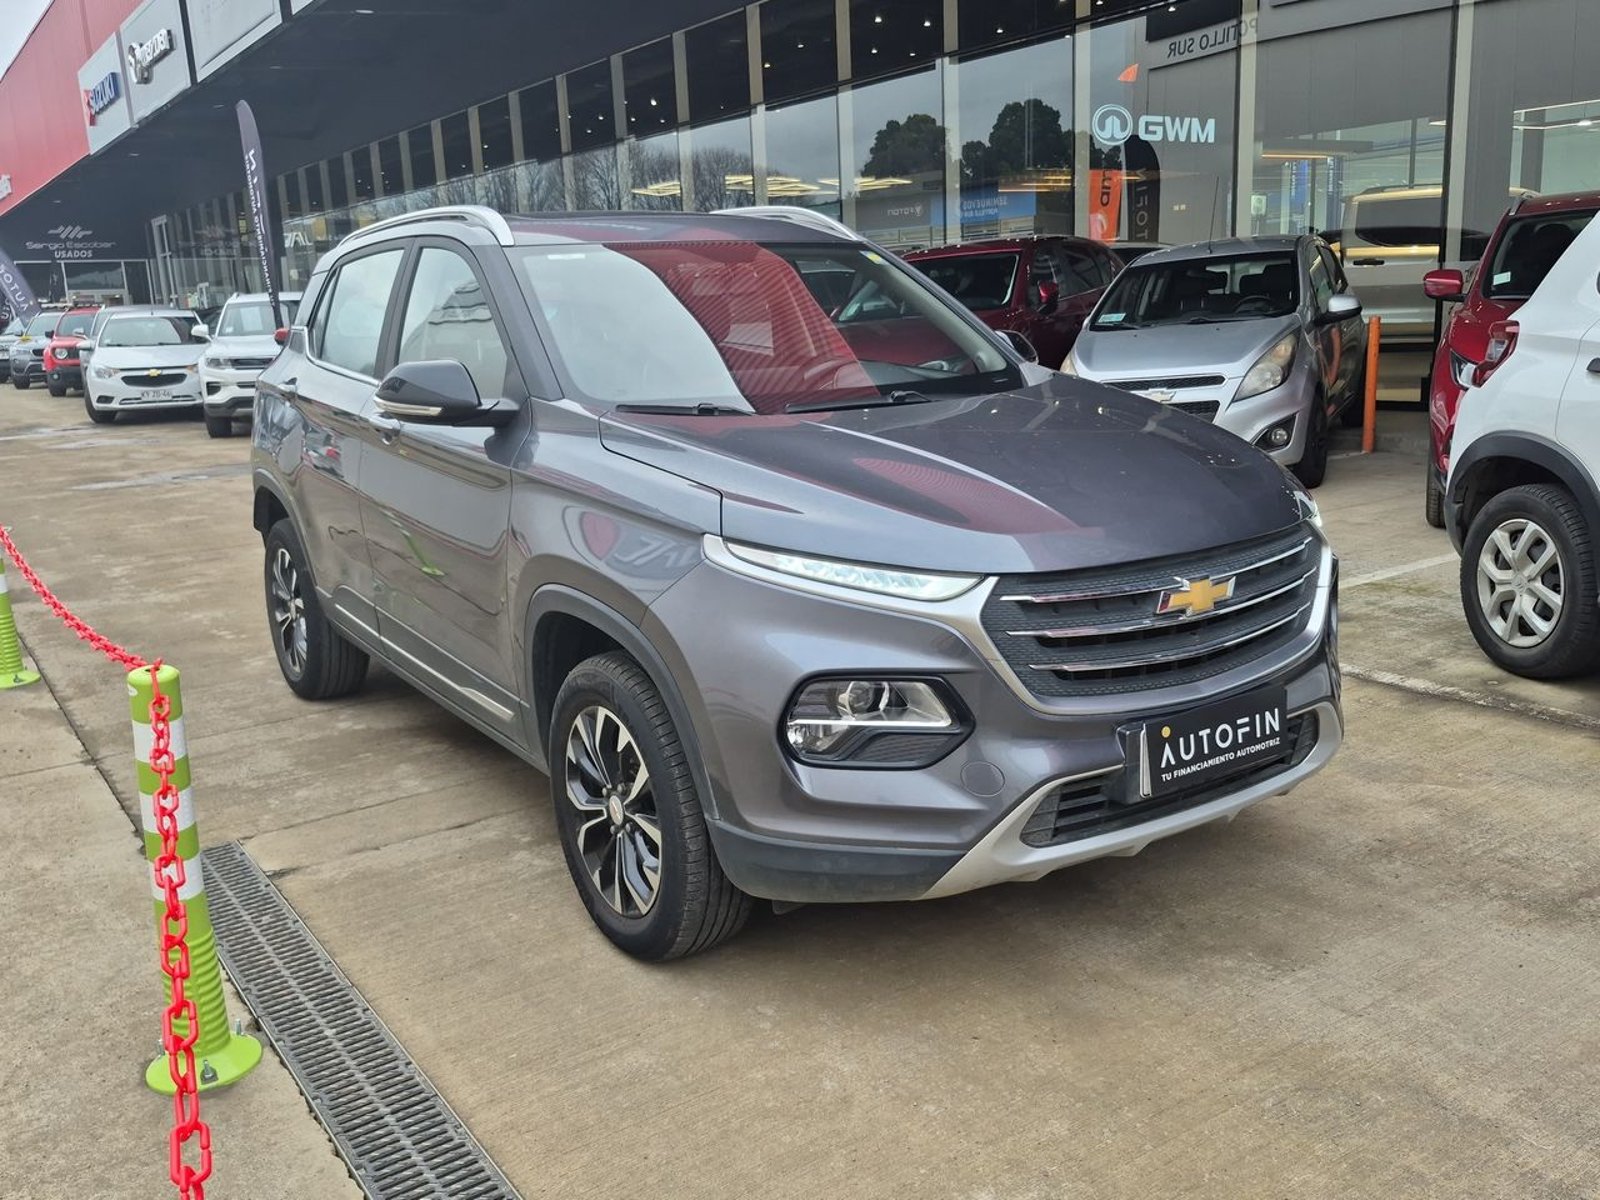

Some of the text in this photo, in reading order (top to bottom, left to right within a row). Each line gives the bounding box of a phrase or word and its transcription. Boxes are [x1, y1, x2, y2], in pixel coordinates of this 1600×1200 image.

[1138, 115, 1216, 144] GWM
[54, 250, 93, 258] USADOS
[1160, 707, 1280, 768] AUTOFIN
[1161, 737, 1281, 782] TU FINANCIAMIENTO AUTOMOTRIZ
